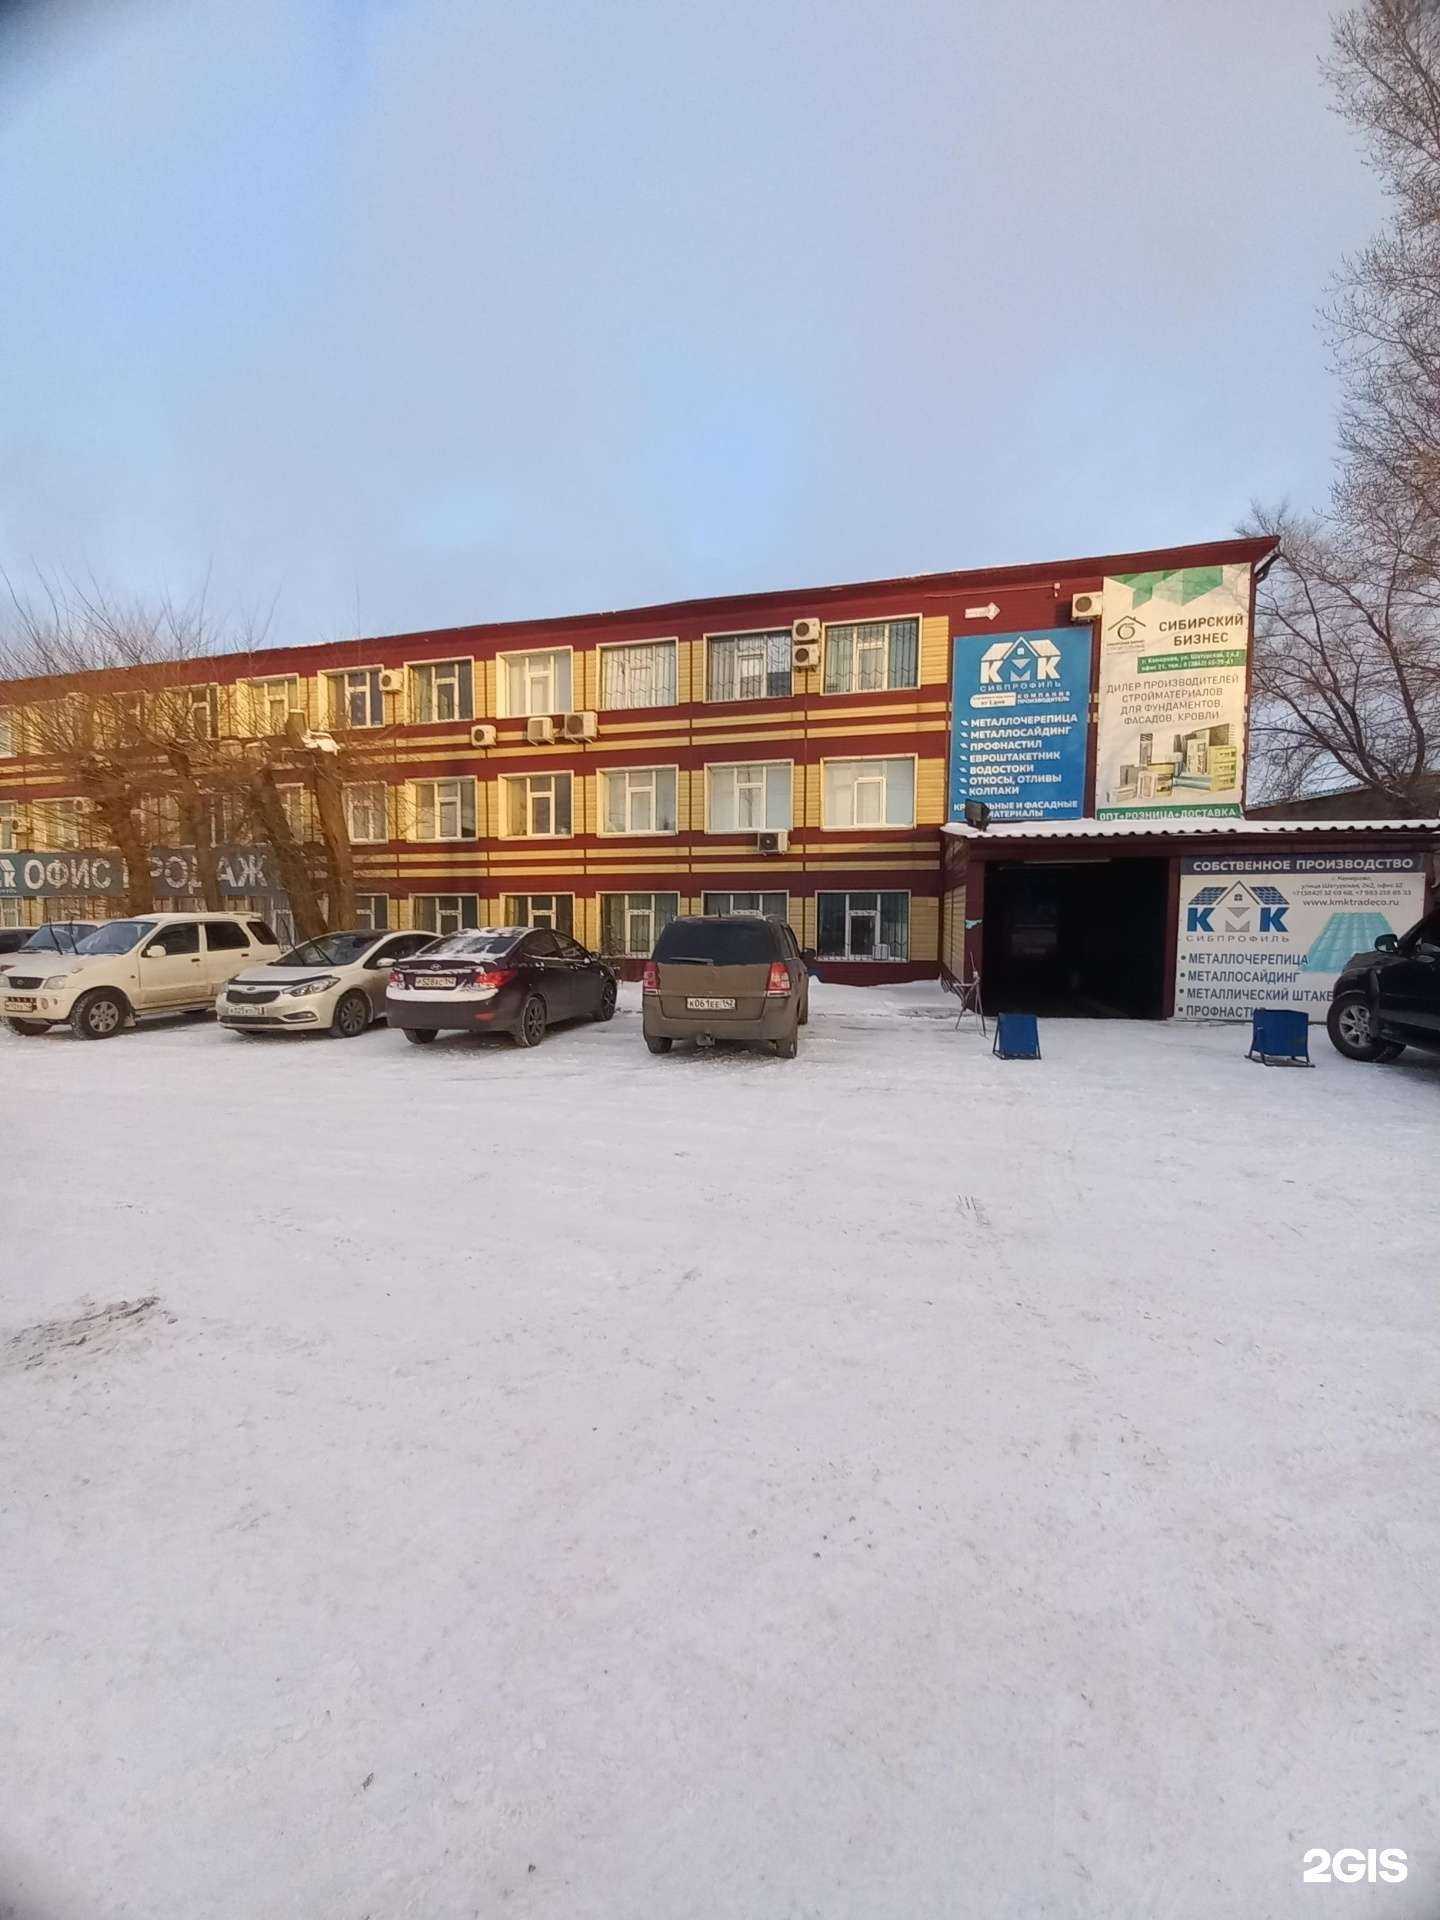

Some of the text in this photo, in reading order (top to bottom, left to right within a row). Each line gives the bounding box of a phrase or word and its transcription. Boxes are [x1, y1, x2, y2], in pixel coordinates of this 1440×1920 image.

[1159, 613, 1244, 632] СИБИРСКИЙ
[1174, 633, 1229, 646] БИЗНЕС
[979, 681, 1062, 692] СИБПРОФИЛЬ
[1106, 673, 1240, 694] ДИЛЕР ПРОИЗВОДИТЕЛЕЙ
[1018, 697, 1070, 705] ПРОИЗВОДИТЕЛЬ
[1122, 687, 1224, 703] СТРОЙМАТЕРИАЛОВ
[1120, 698, 1224, 715] ДЛЯ ФУНДАМЕНТОВ,
[971, 714, 1078, 728] МЕТАЛЛОЧЕРЕПИЦА
[1124, 711, 1219, 725] ФАСАДОВ, КРОВЛИ
[971, 726, 1073, 740] МЕТАЛЛОСАЙДИНГ
[970, 740, 1043, 751] ПРОФНАСТИЛ
[970, 751, 1061, 763] ЕВРОШТАКЕТНИК
[970, 764, 1034, 774] ВОДОСТОКИ
[969, 774, 1062, 786] ОТКОСЫ, ОТЛИВЫ
[969, 787, 1020, 797] КОЛПАКИ
[954, 802, 1015, 811] КРЬНЫЕ
[1024, 800, 1078, 810] ФАСАДНЫЕ
[1193, 859, 1414, 871] СОБСТВЕННОЕ ПРОИЗВОДСТВО
[24, 856, 112, 889] ОФИС
[1303, 898, 1399, 907] www.kmktradeco.ru
[1186, 935, 1290, 943] СИБПРОФИЛЬ
[1189, 953, 1309, 966] МЕТАЛЛОЧЕРЕПИЦА
[1188, 970, 1300, 985] МЕТАЛЛОСАЙДИНГ
[1187, 987, 1289, 1001] МЕТАЛЛИЧЕСКИЙ
[1186, 1005, 1265, 1017] ПРОФНАСТ
